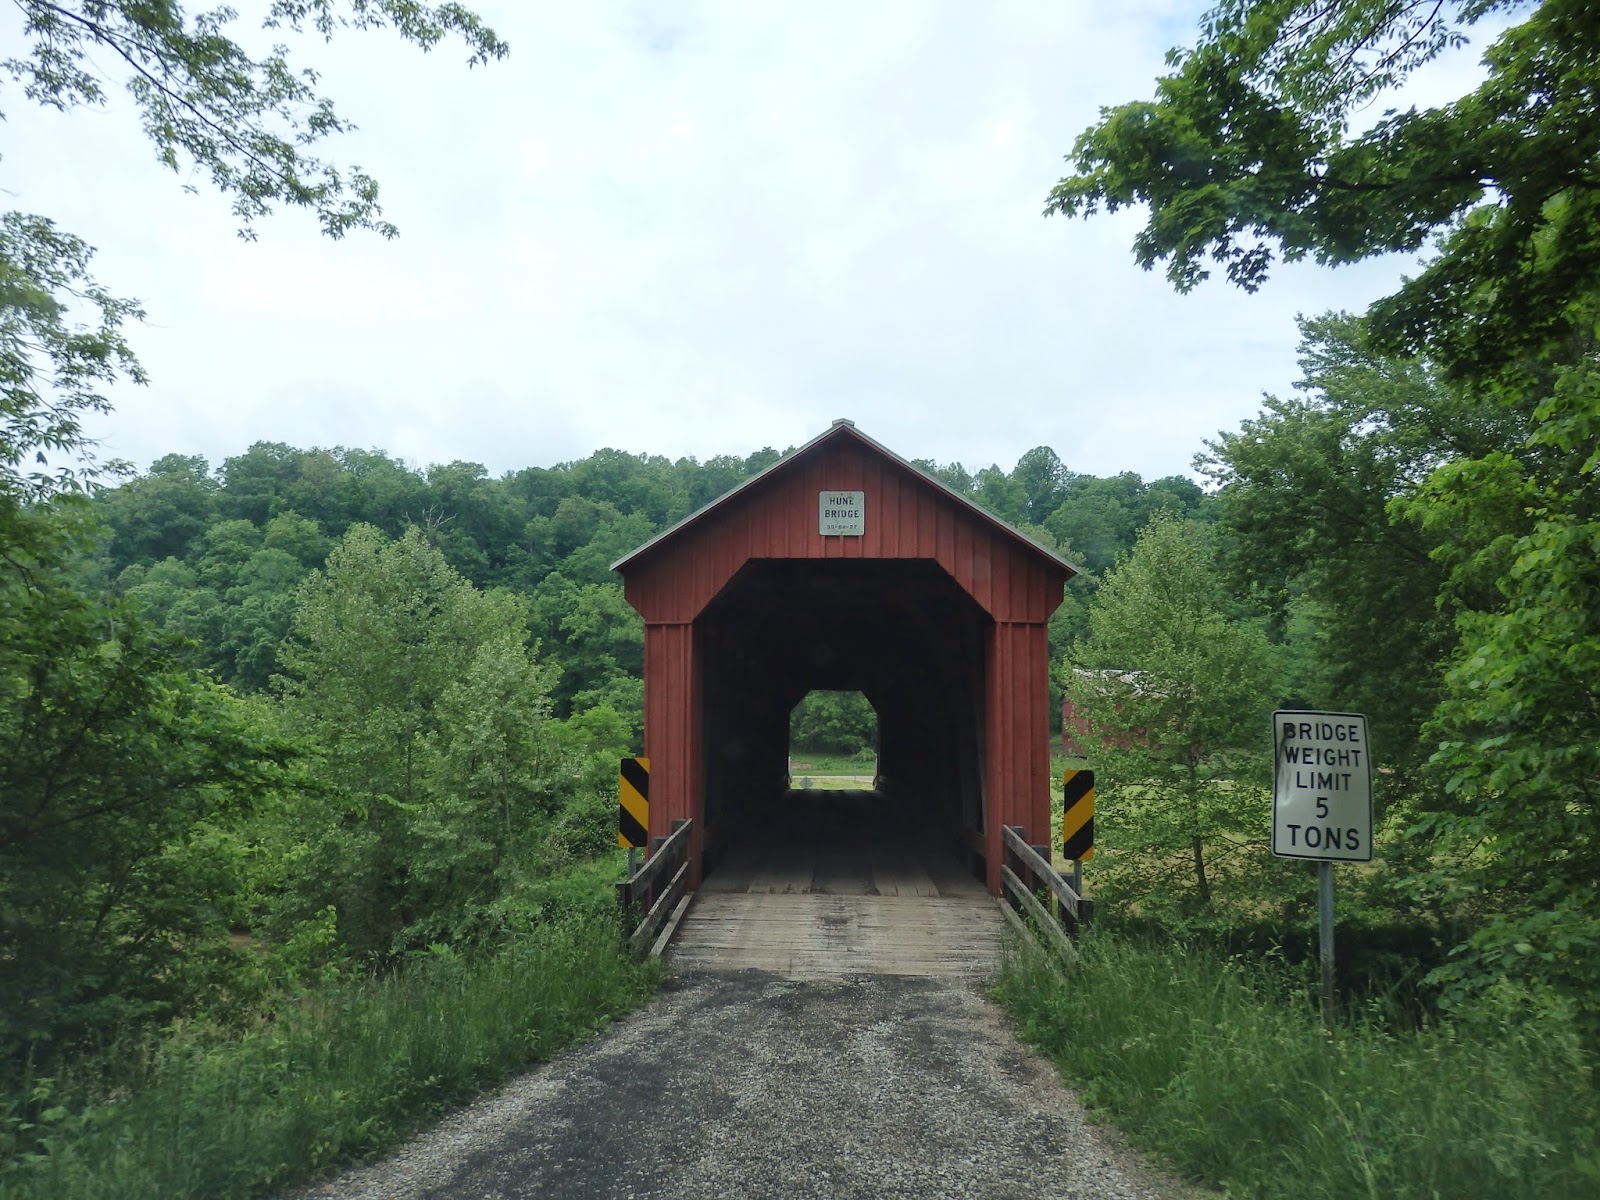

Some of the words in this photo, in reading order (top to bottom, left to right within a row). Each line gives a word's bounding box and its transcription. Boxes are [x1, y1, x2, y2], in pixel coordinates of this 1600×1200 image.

[829, 497, 854, 505] HUNE
[824, 509, 859, 518] BRIDGE
[1283, 722, 1359, 742] BRIDGE
[1285, 746, 1361, 767] WEIGHT
[1297, 771, 1351, 791] LIMIT
[1316, 797, 1329, 819] 5
[1287, 824, 1360, 850] TONS
